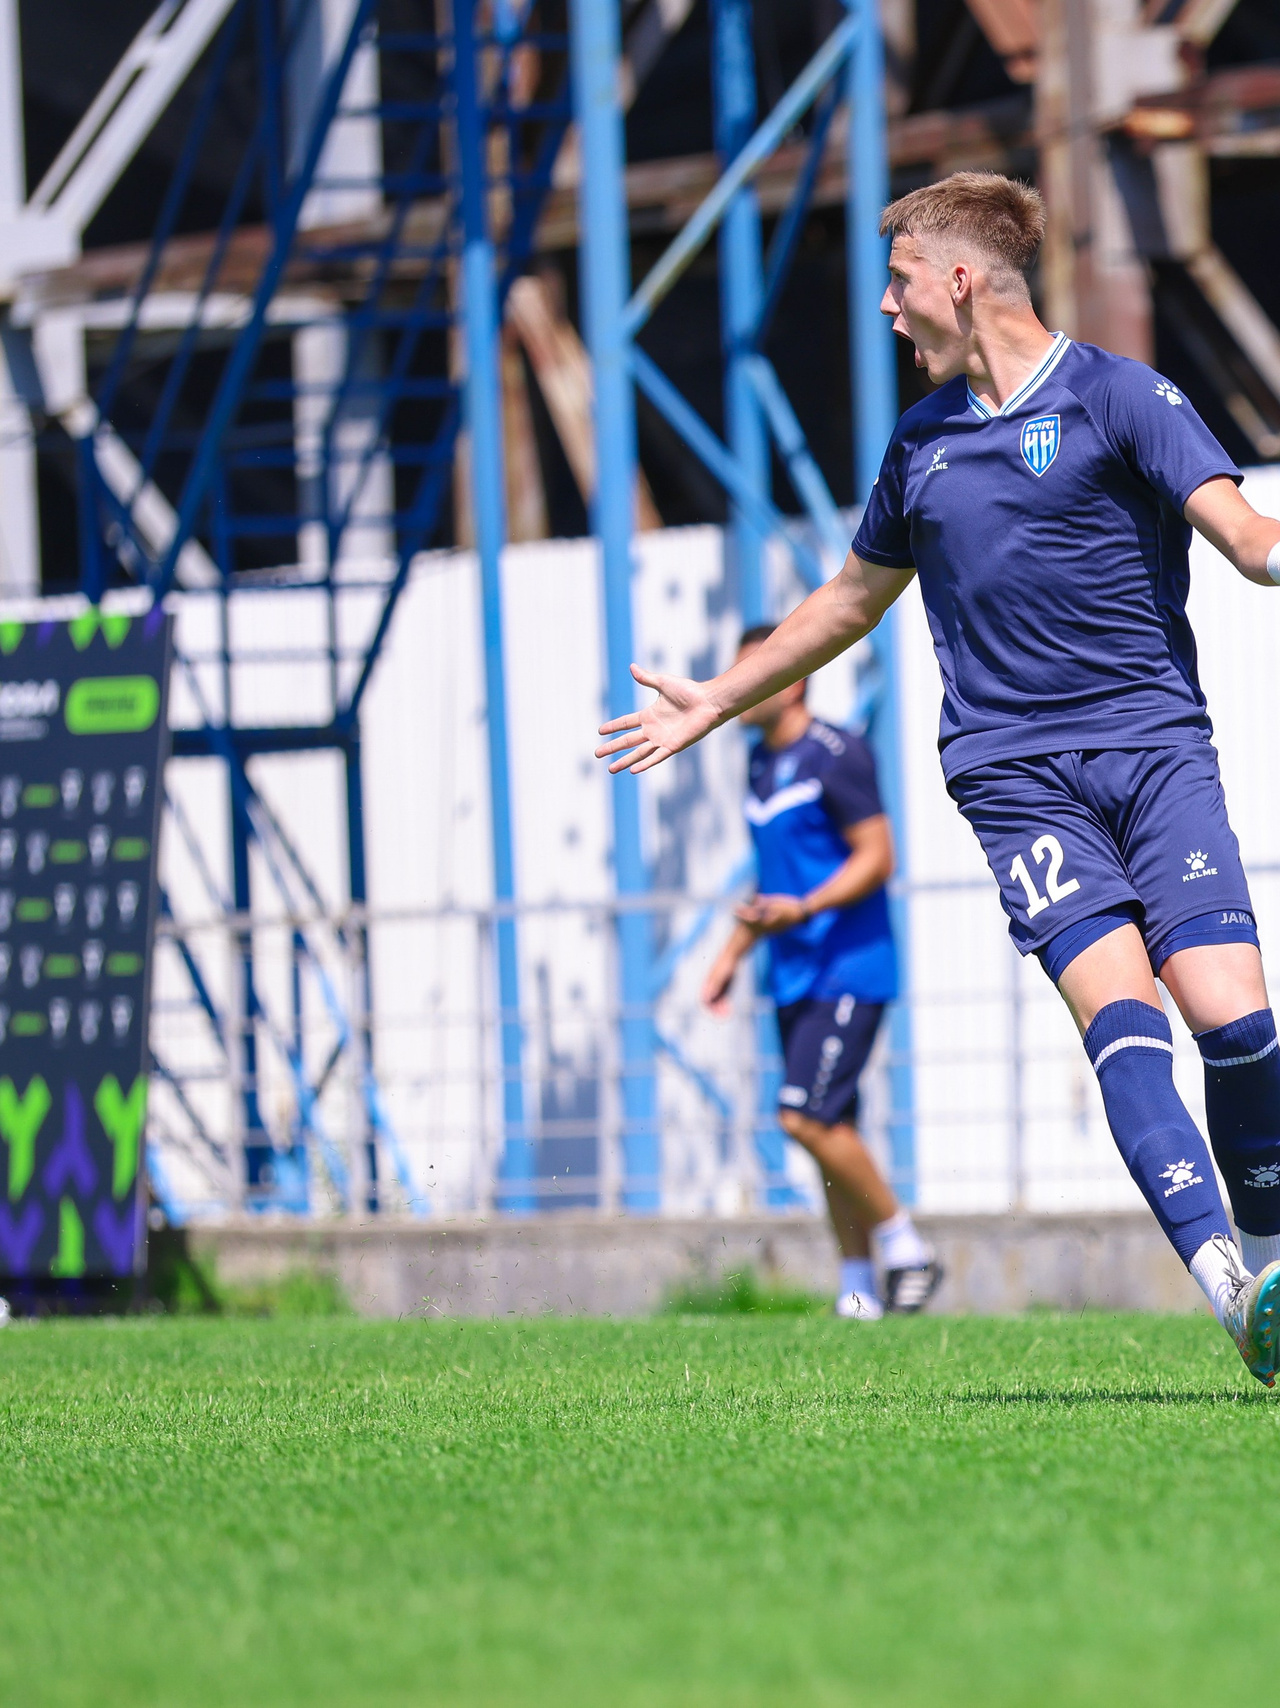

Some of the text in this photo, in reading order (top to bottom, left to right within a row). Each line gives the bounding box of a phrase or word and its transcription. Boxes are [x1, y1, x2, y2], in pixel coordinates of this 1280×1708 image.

[1026, 420, 1055, 432] PARI
[1009, 834, 1081, 920] 12
[1182, 868, 1218, 883] KELME
[1164, 1175, 1203, 1198] KELME
